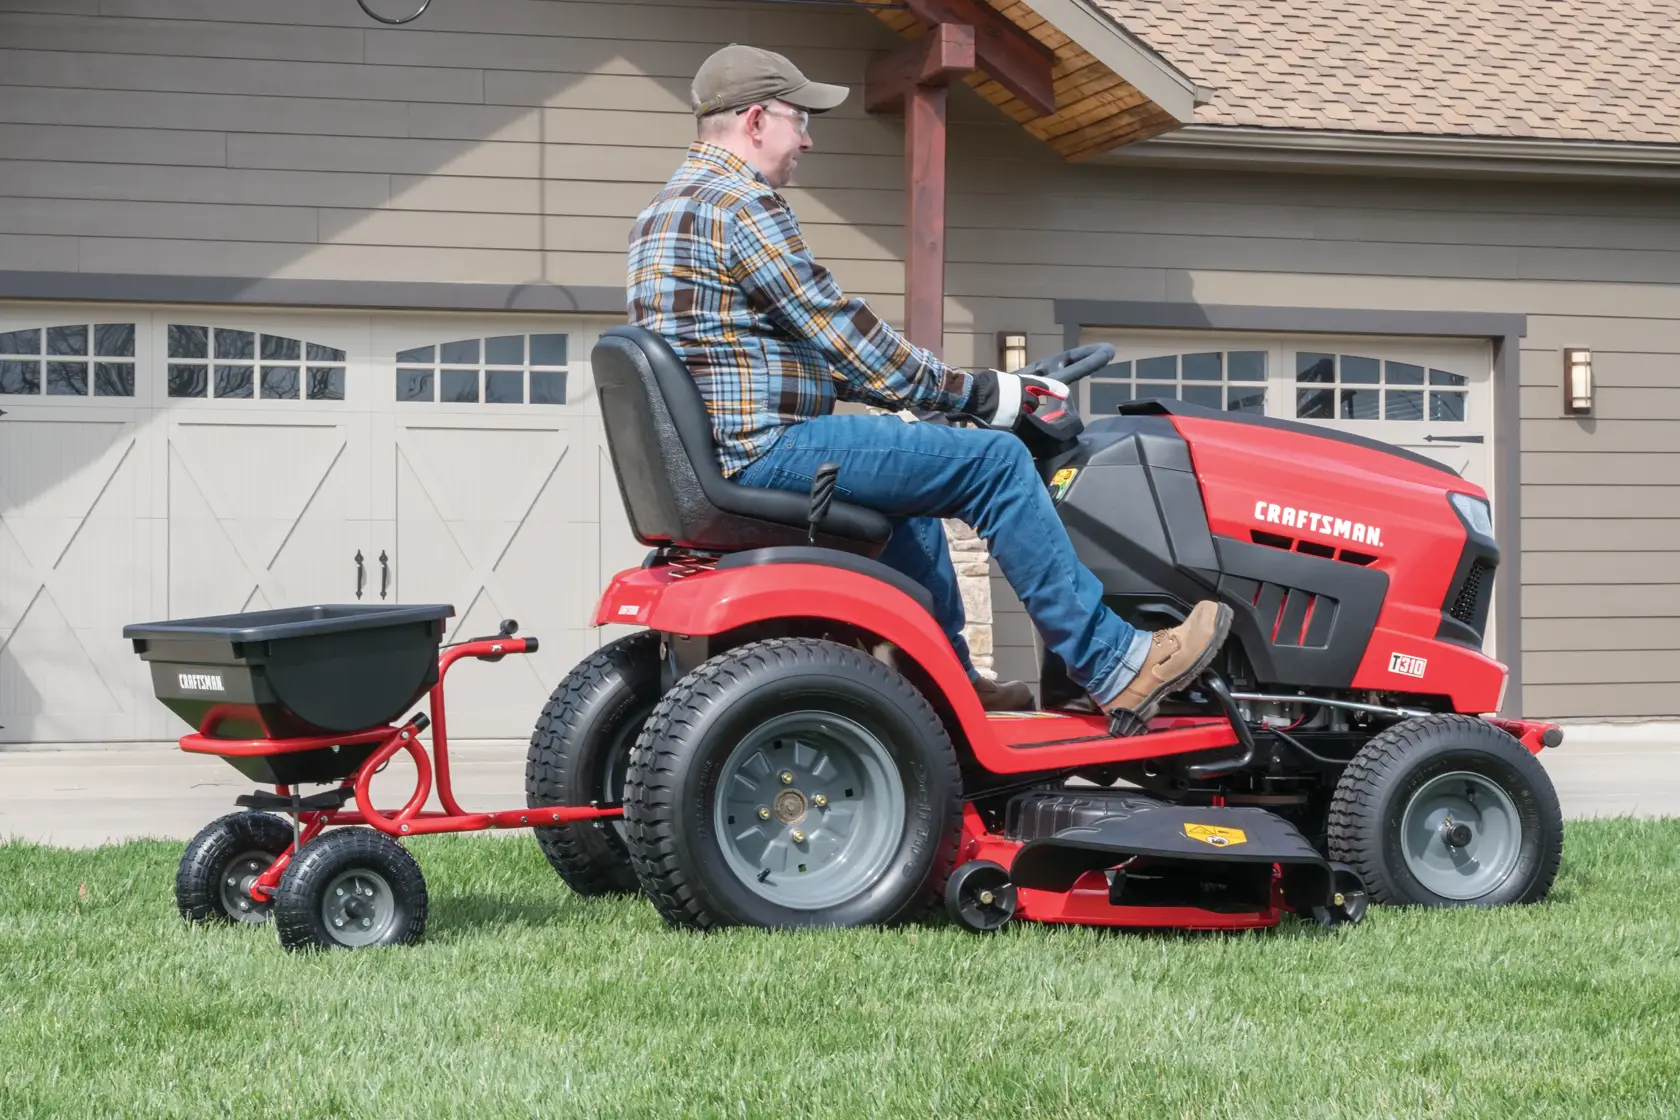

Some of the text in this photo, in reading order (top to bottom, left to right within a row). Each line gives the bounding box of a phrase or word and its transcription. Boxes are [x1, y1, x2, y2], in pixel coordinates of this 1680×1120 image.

[1254, 501, 1383, 547] CRAFTSMAN
[1392, 654, 1426, 677] T310
[178, 673, 224, 691] CRAFTSMAN
